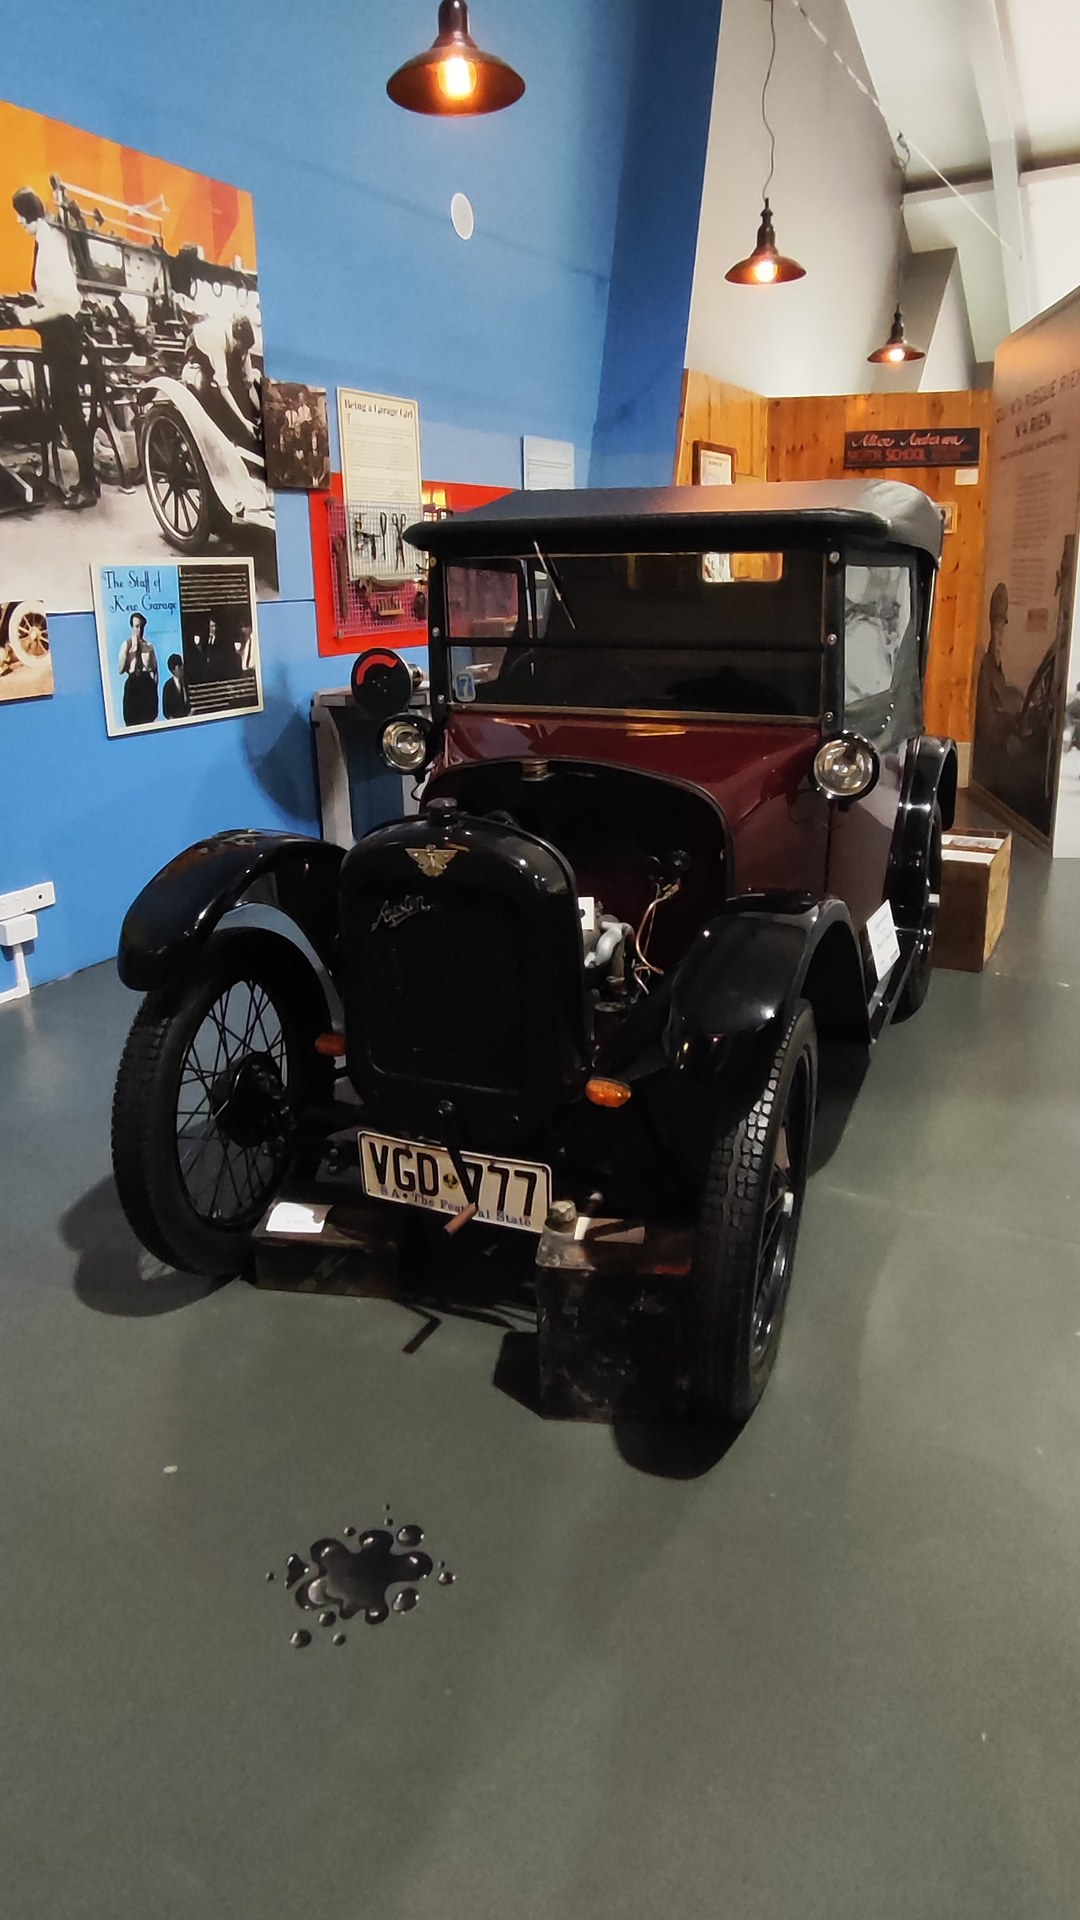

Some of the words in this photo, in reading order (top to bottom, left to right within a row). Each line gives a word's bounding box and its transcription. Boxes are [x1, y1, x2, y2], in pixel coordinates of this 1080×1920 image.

[344, 399, 367, 412] Being
[373, 404, 398, 417] Garage
[886, 447, 925, 462] SCHOOL
[102, 569, 124, 589] The
[128, 569, 151, 594] Staff
[153, 570, 162, 593] of
[110, 594, 138, 613] Kew
[141, 593, 177, 616] Garage
[369, 1141, 440, 1197] VGD
[462, 1159, 538, 1217] 777
[412, 1191, 435, 1208] The
[496, 1209, 532, 1227] State
